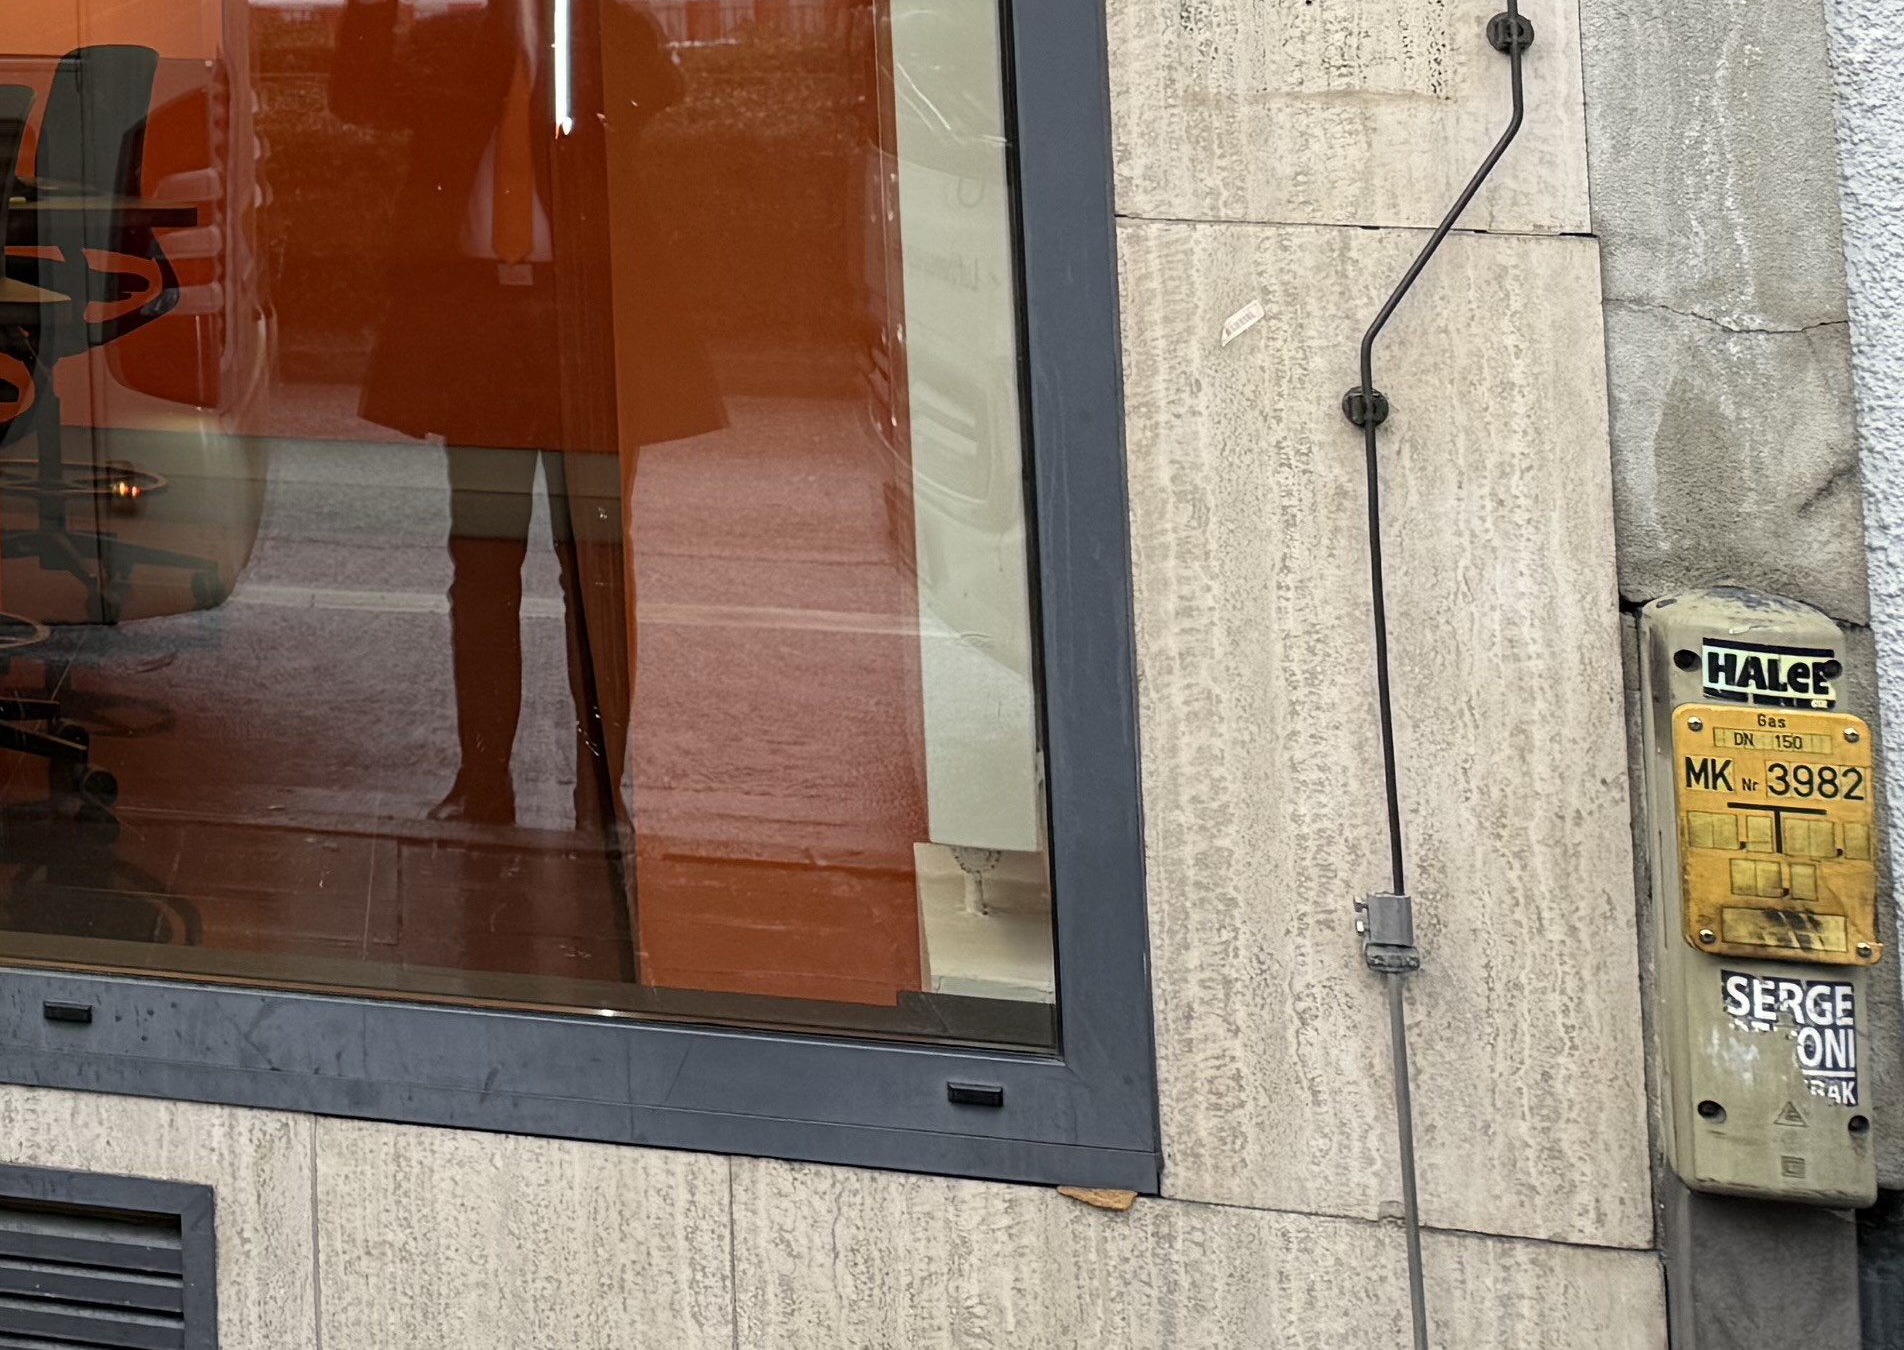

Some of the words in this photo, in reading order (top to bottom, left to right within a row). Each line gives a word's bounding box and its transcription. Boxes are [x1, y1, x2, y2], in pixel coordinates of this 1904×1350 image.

[1757, 713, 1786, 729] Gas
[1733, 732, 1754, 747] DN
[1775, 734, 1803, 749] 150
[1685, 756, 1735, 792] MK
[1742, 778, 1760, 792] Nr
[1767, 762, 1865, 801] 3982
[1726, 975, 1855, 1026] SERGE
